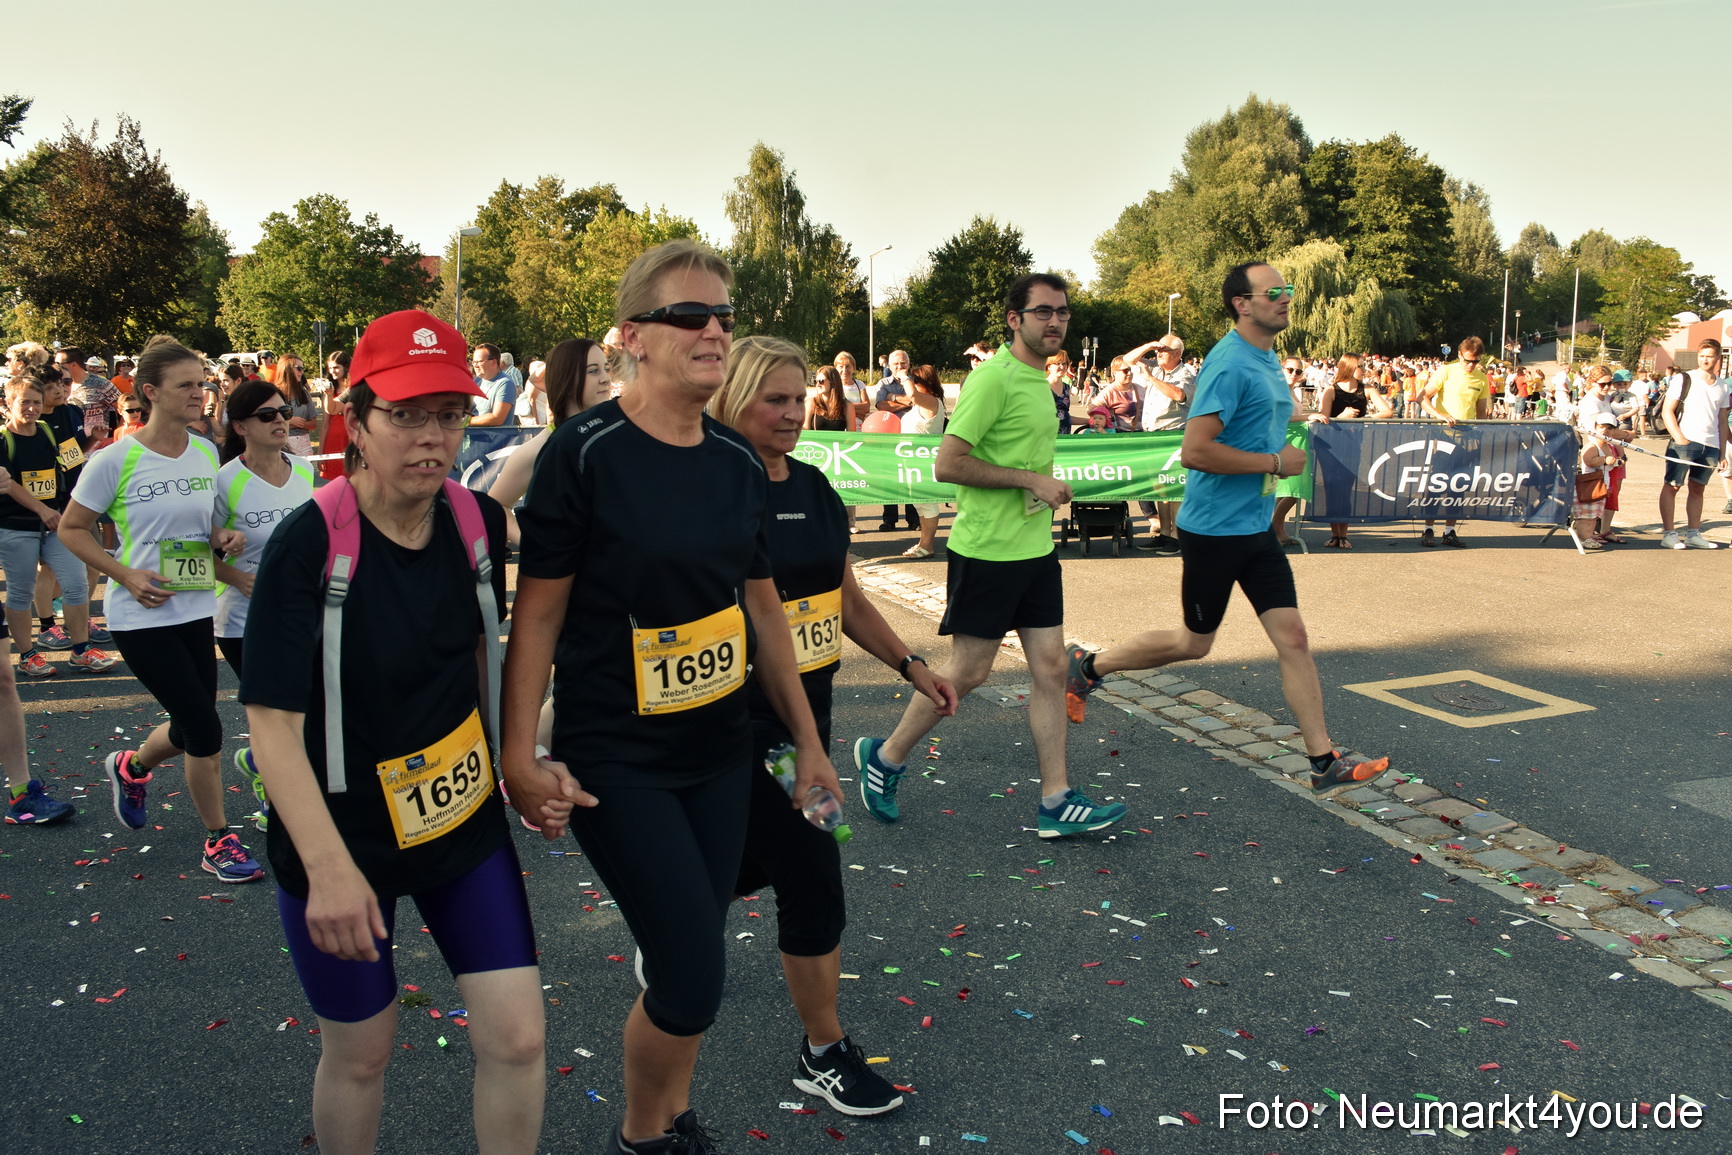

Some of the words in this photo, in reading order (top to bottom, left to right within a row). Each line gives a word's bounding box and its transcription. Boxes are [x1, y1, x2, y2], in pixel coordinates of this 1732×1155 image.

[408, 348, 448, 356] Oberpfalz
[60, 447, 80, 464] 1709
[786, 441, 868, 476] OK
[894, 441, 940, 459] Ges
[897, 463, 922, 484] in
[1052, 463, 1132, 481] änden
[1158, 473, 1176, 484] Die
[1178, 473, 1187, 484] G
[1398, 465, 1530, 493] Fischer
[28, 479, 55, 493] 1708
[829, 478, 870, 490] skasse.
[1407, 496, 1517, 508] AUTOMOBILE
[175, 558, 207, 576] 705
[797, 614, 839, 651] 1637
[653, 641, 734, 689] 1699
[659, 688, 690, 699] Weber
[691, 673, 732, 693] Rosemarie
[670, 695, 693, 704] Wagner
[693, 688, 715, 699] Stiftung
[399, 756, 442, 781] firmenlauf
[393, 777, 430, 795] walken
[406, 750, 481, 817] 1659
[422, 800, 464, 826] Hoffmann
[464, 783, 481, 802] Heike
[404, 827, 430, 839] Regens
[430, 815, 453, 831] Wagner
